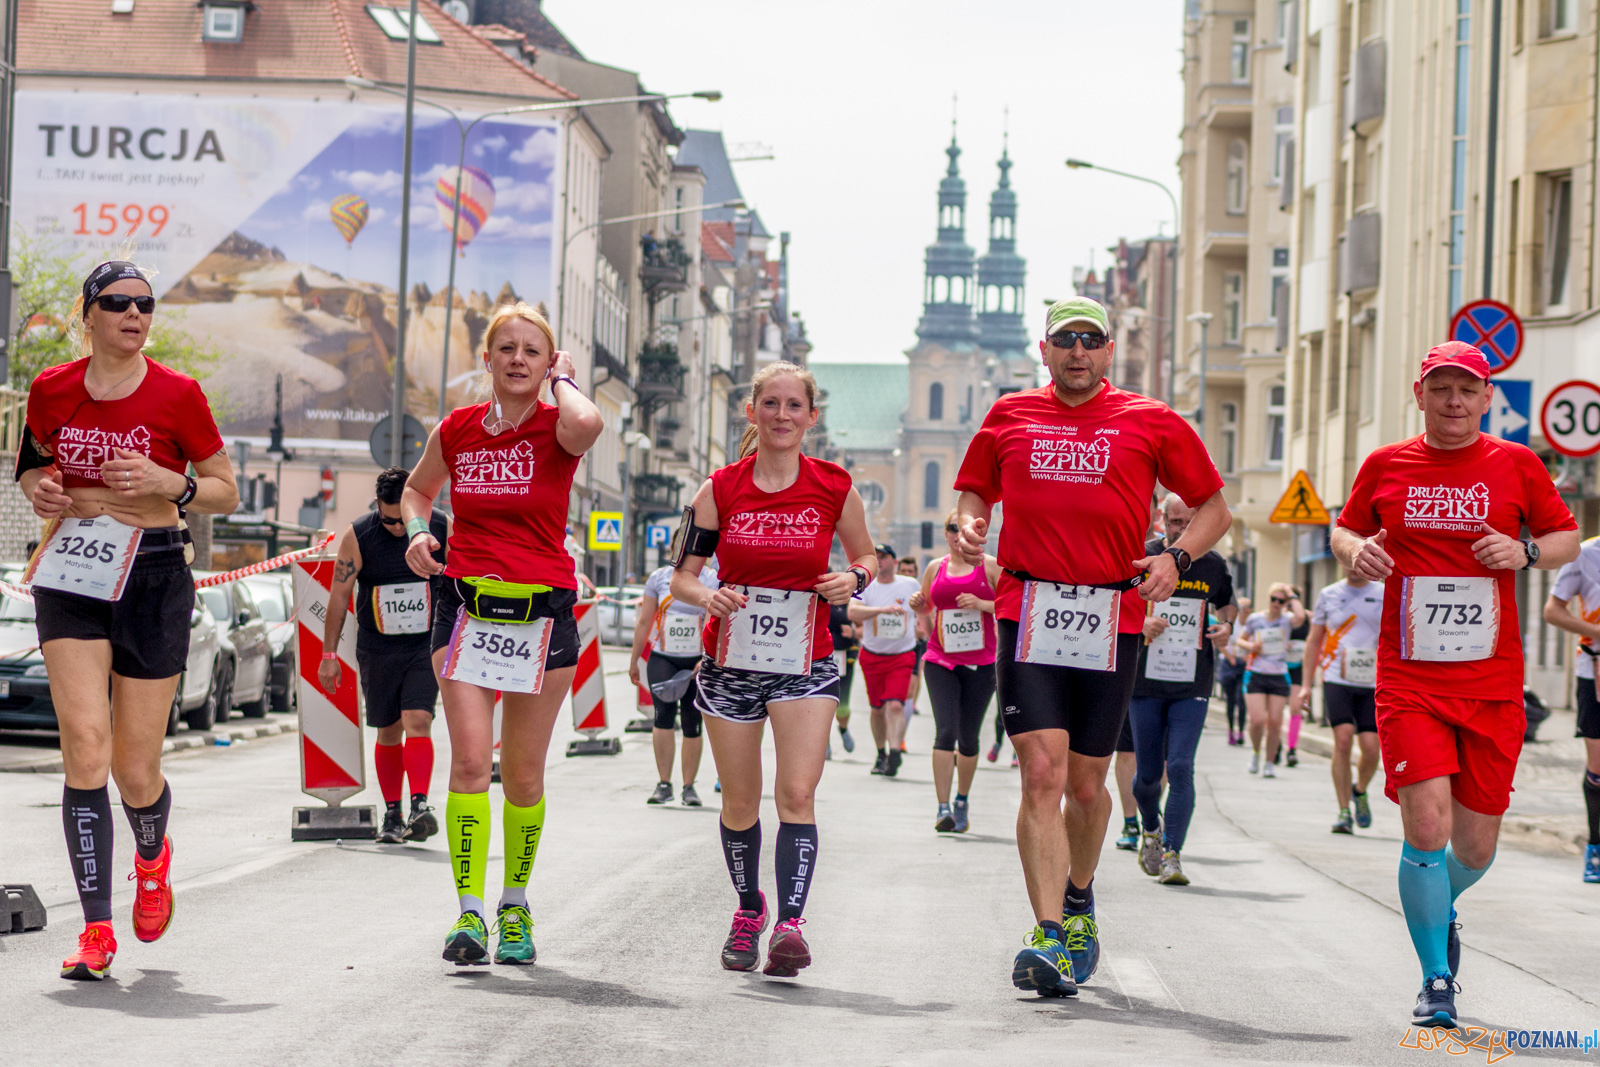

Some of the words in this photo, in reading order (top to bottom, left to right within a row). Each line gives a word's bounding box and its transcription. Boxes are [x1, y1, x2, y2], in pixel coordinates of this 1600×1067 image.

[38, 124, 226, 162] TURCJA
[128, 172, 152, 186] jest
[1552, 400, 1600, 436] 30
[59, 427, 134, 447] DRUŻYNA
[1032, 439, 1097, 453] DRUŻYNA
[455, 448, 519, 465] DRUŻYNA
[1030, 452, 1110, 472] SZPIKU
[455, 461, 535, 483] SZPIKU
[1031, 472, 1102, 485] www.darszpiku.pl
[455, 485, 529, 496] www.darszpiku.pl
[1407, 484, 1475, 500] DRUŻYNA
[1404, 500, 1490, 520] SZPIKU
[1404, 520, 1483, 533] www.darszpiku.pl
[651, 528, 667, 545] P
[726, 537, 815, 549] www.darszpiku.pl
[55, 536, 117, 564] 3265
[65, 560, 93, 570] Matylda
[385, 598, 424, 613] 11646
[1425, 603, 1482, 625] 7732
[750, 614, 788, 637] 195
[945, 621, 980, 634] 10633
[1044, 608, 1101, 634] 8979
[669, 627, 696, 637] 8027
[1438, 628, 1470, 636] Sławomir
[472, 631, 531, 660] 3584
[751, 640, 782, 648] Adrianna
[481, 656, 515, 669] Agnieszka
[72, 807, 99, 892] kalenji
[456, 815, 479, 889] kalenji
[513, 824, 541, 883] kalenji
[727, 841, 748, 893] kalenji
[788, 838, 815, 907] kalenji
